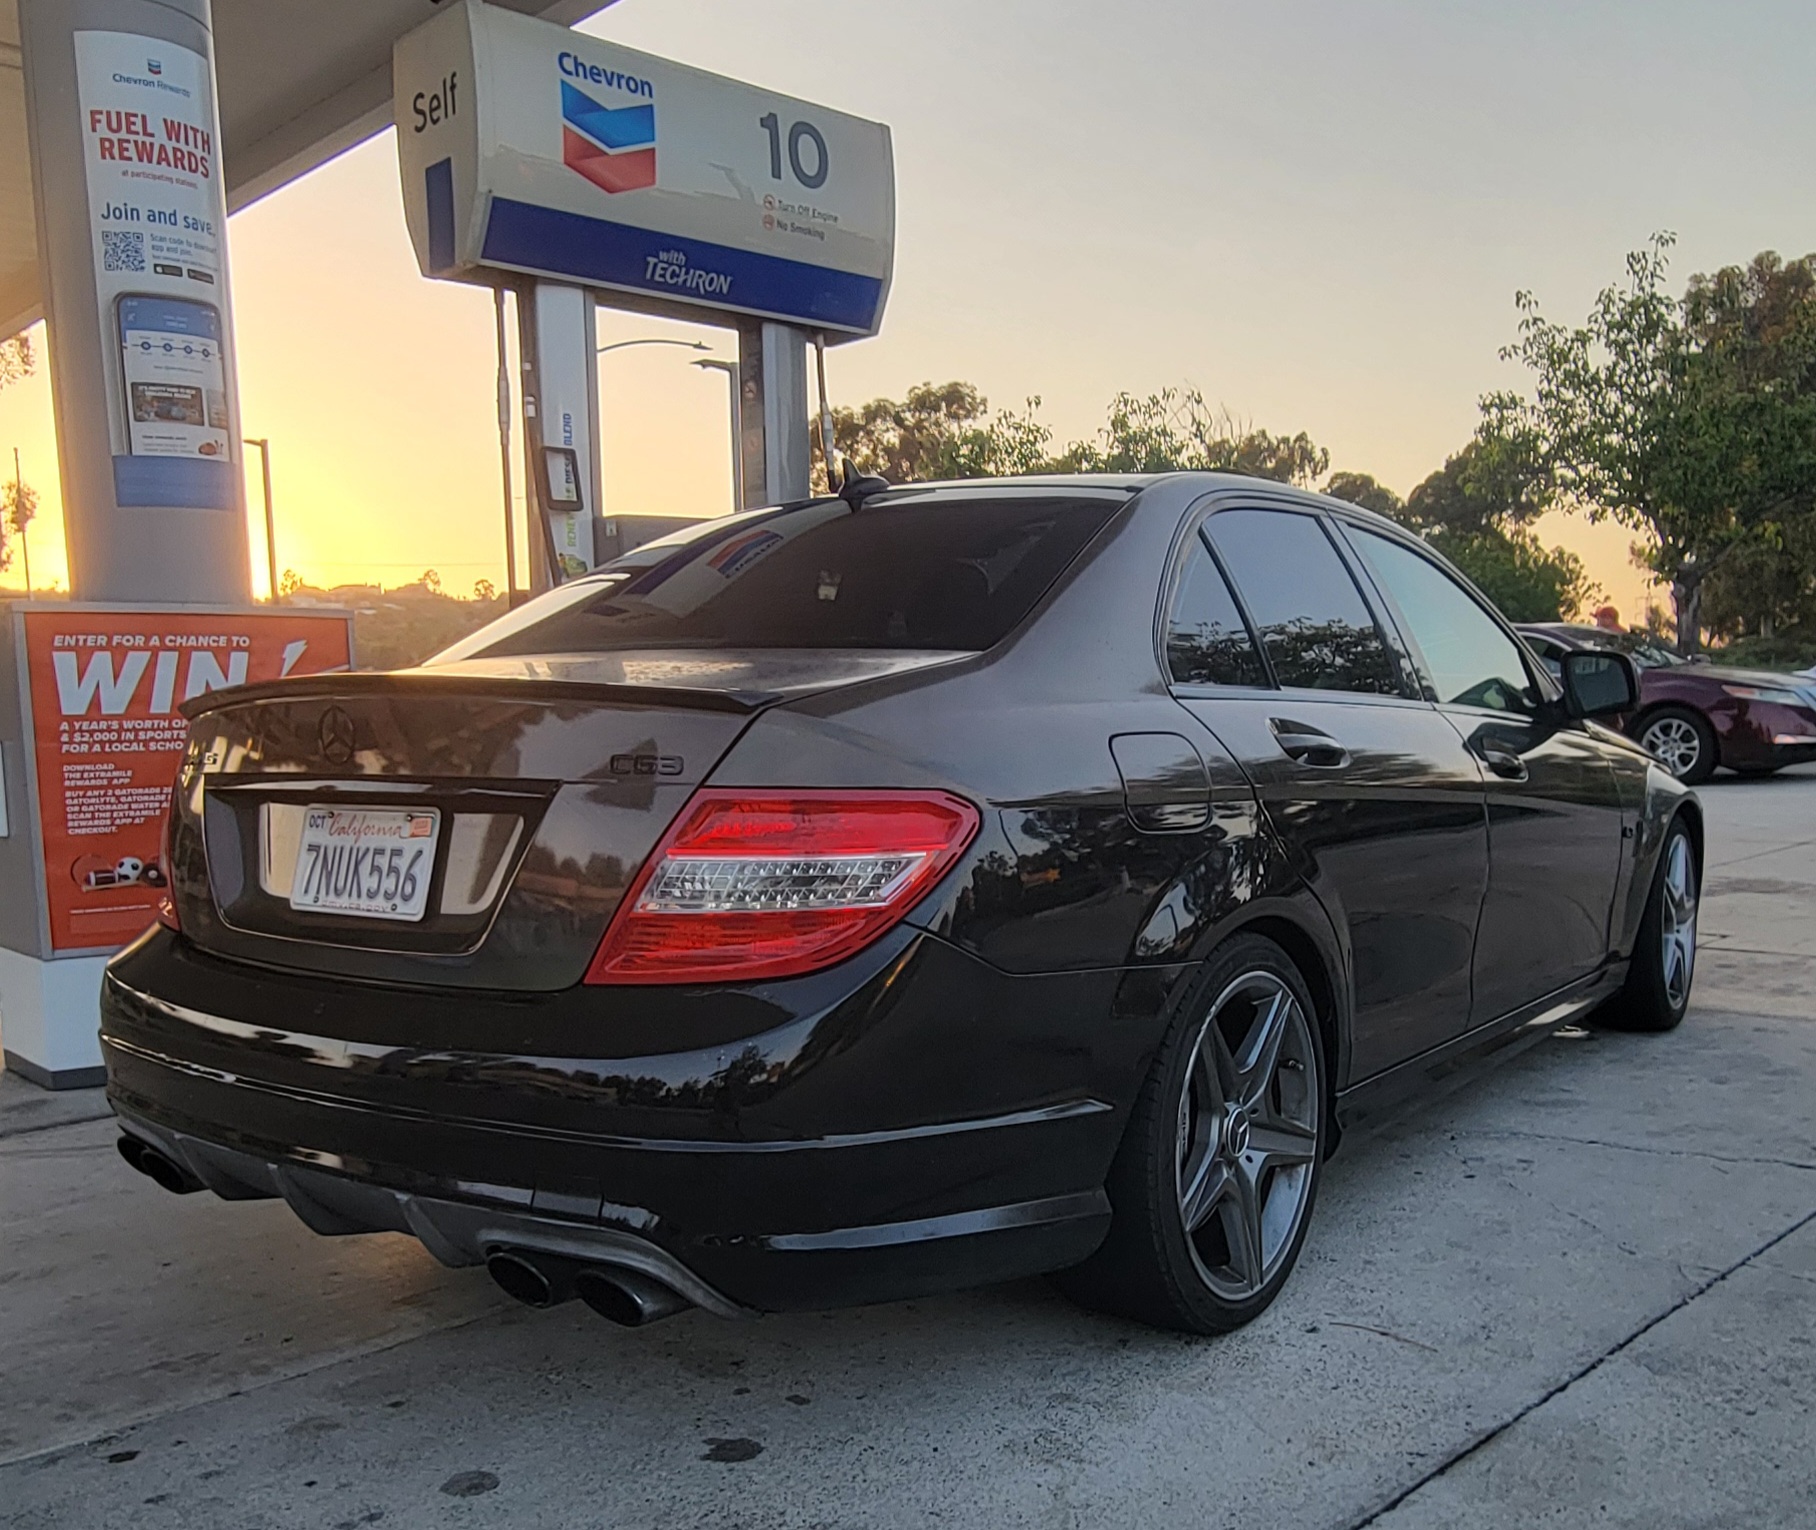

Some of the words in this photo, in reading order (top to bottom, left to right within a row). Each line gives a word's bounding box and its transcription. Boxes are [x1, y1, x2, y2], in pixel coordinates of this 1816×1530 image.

[558, 52, 653, 99] Chevron
[112, 73, 156, 88] Chevron
[156, 81, 191, 98] Rewards
[412, 71, 457, 133] Self
[90, 109, 155, 138] FUEL
[162, 117, 211, 156] WITH
[99, 137, 210, 179] REWARDS
[760, 112, 829, 189] 10
[131, 171, 174, 185] participating
[101, 202, 140, 221] Join
[147, 208, 178, 227] and
[777, 198, 796, 213] Turn
[797, 204, 810, 216] Off
[812, 208, 839, 224] Engine
[776, 219, 788, 231] No
[790, 222, 826, 242] Smoking
[150, 233, 167, 243] Scan
[169, 237, 184, 246] code
[186, 239, 193, 248] to
[659, 250, 687, 266] with
[646, 256, 732, 295] TECHRON
[562, 413, 573, 446] BLEND
[53, 634, 108, 647] ENTER
[112, 635, 145, 647] FOR
[150, 635, 160, 647] A
[165, 635, 227, 647] CHANCE
[231, 636, 250, 647] TO
[52, 650, 249, 715] WIN
[60, 721, 69, 731] A
[73, 721, 119, 730] YEAR'S
[122, 719, 169, 729] WORTH
[60, 732, 69, 742] &
[73, 731, 118, 743] $2,000
[121, 731, 135, 740] IN
[138, 730, 187, 739] SPORTS
[62, 743, 89, 753] FOR
[91, 743, 101, 753] A
[105, 742, 146, 752] LOCAL
[63, 764, 115, 772] DOWNLOAD
[83, 770, 133, 778] EXTRAMILE
[65, 790, 84, 798] BUY
[85, 789, 106, 797] ANY
[114, 787, 160, 796] GATORADE
[120, 795, 166, 803] GATORADE
[81, 803, 129, 811] GATORADE
[94, 811, 111, 819] THE
[113, 809, 161, 818] EXTRAMILE
[68, 826, 118, 835] CHECKOUT.
[309, 814, 326, 828] OCT
[328, 813, 403, 844] California
[303, 844, 424, 902] 7NUK556
